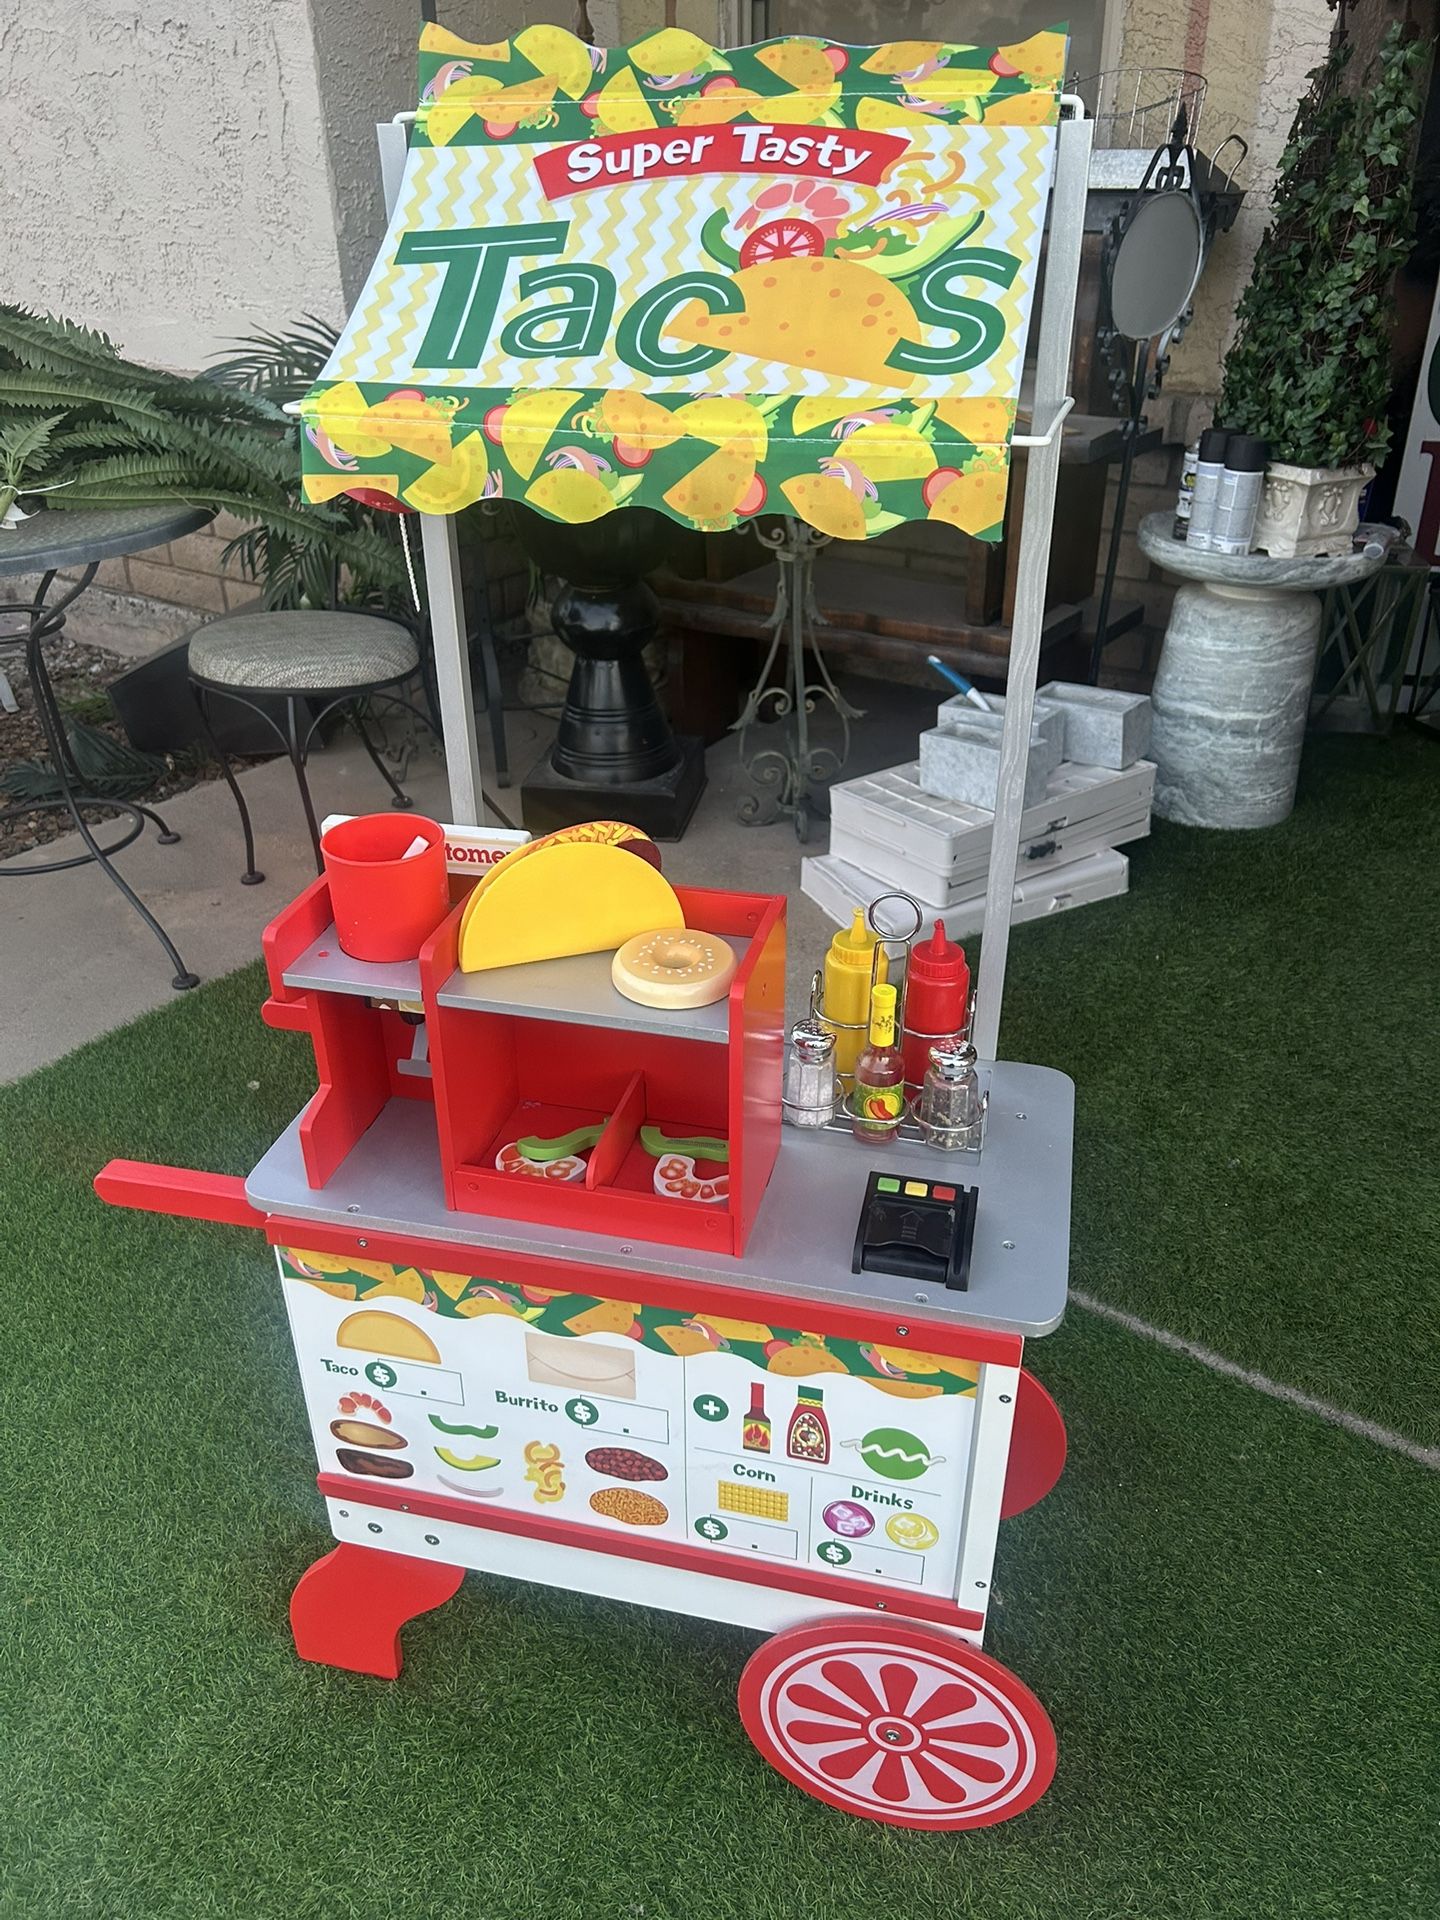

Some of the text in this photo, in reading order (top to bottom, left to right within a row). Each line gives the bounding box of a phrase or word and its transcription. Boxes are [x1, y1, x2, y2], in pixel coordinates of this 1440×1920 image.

[566, 124, 873, 183] Super Tasty
[445, 843, 511, 863] tome
[320, 1358, 359, 1376] Taco
[495, 1390, 559, 1413] Burrito
[733, 1463, 776, 1482] Corn
[851, 1485, 914, 1510] Drinks
